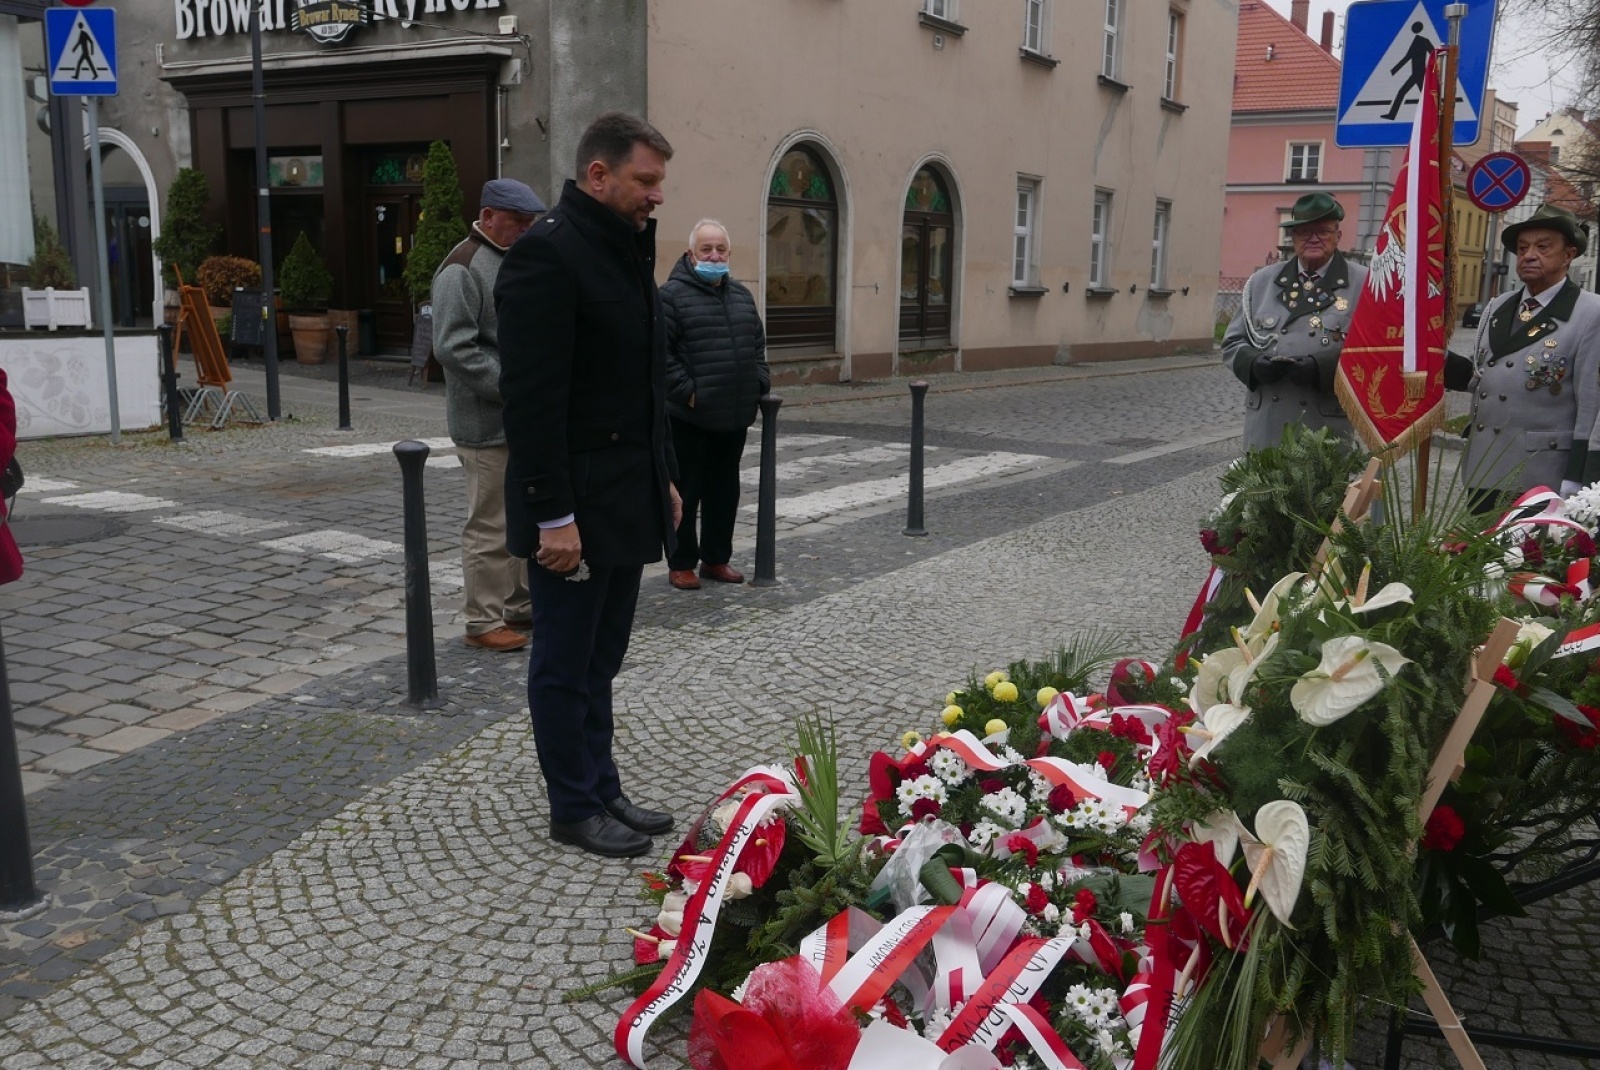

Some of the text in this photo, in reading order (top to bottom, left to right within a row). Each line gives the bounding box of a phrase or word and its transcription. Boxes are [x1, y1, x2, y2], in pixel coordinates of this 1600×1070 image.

[174, 0, 286, 39] Browar
[298, 9, 330, 27] Browar
[331, 3, 360, 23] Rynek
